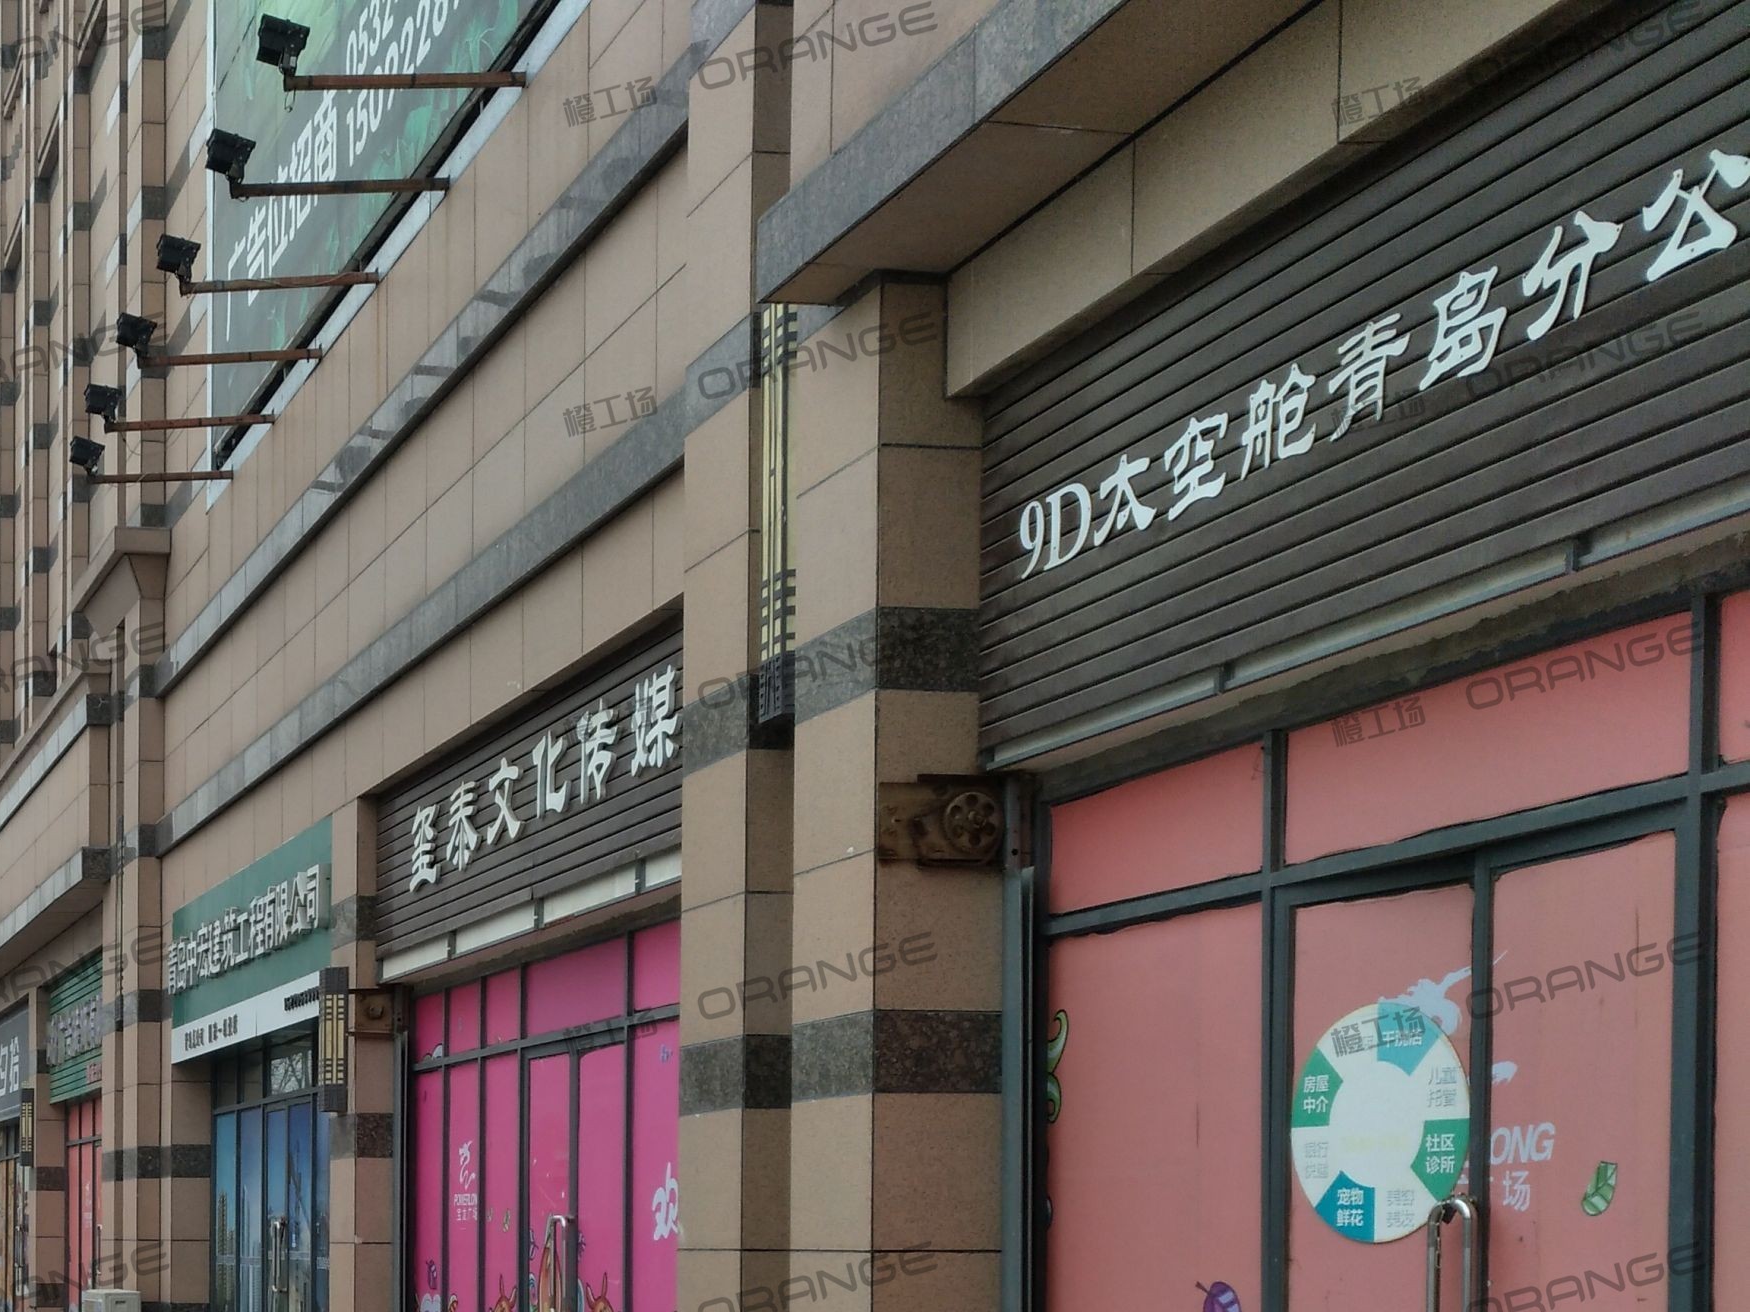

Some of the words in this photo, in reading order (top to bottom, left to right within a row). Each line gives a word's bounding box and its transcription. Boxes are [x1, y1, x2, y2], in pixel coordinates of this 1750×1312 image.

[345, 0, 459, 166] 1509228
[226, 88, 338, 342] 广告位招商
[1018, 148, 1750, 580] 9D太空舱青岛分公
[408, 664, 680, 893] 玺泰文化传媒
[1303, 1075, 1330, 1093] 房屋
[1303, 1096, 1330, 1115] 中介
[1425, 1133, 1456, 1152] 社区
[1425, 1155, 1456, 1175] 诊所
[1336, 1187, 1365, 1206] 宠物
[1336, 1208, 1365, 1228] 鲜花
